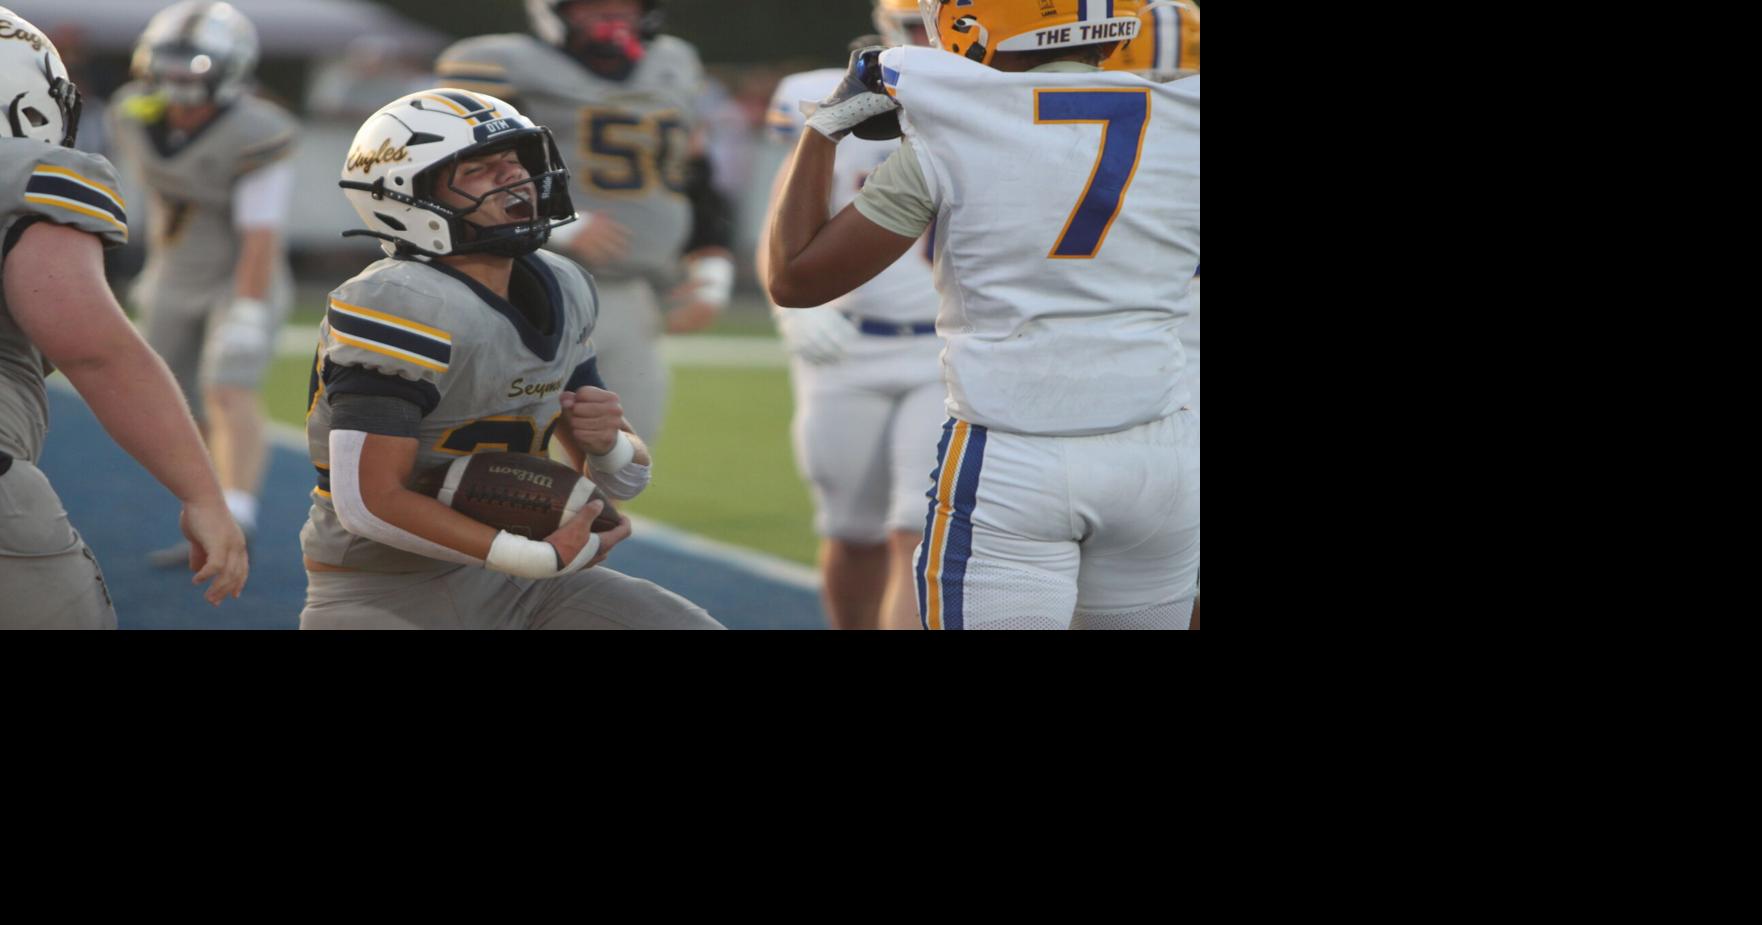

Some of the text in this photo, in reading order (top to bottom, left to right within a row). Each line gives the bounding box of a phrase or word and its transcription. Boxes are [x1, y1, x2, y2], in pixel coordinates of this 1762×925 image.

[1036, 21, 1137, 46] THE THICKET
[1034, 88, 1151, 259] 7
[489, 465, 554, 488] Wilson
